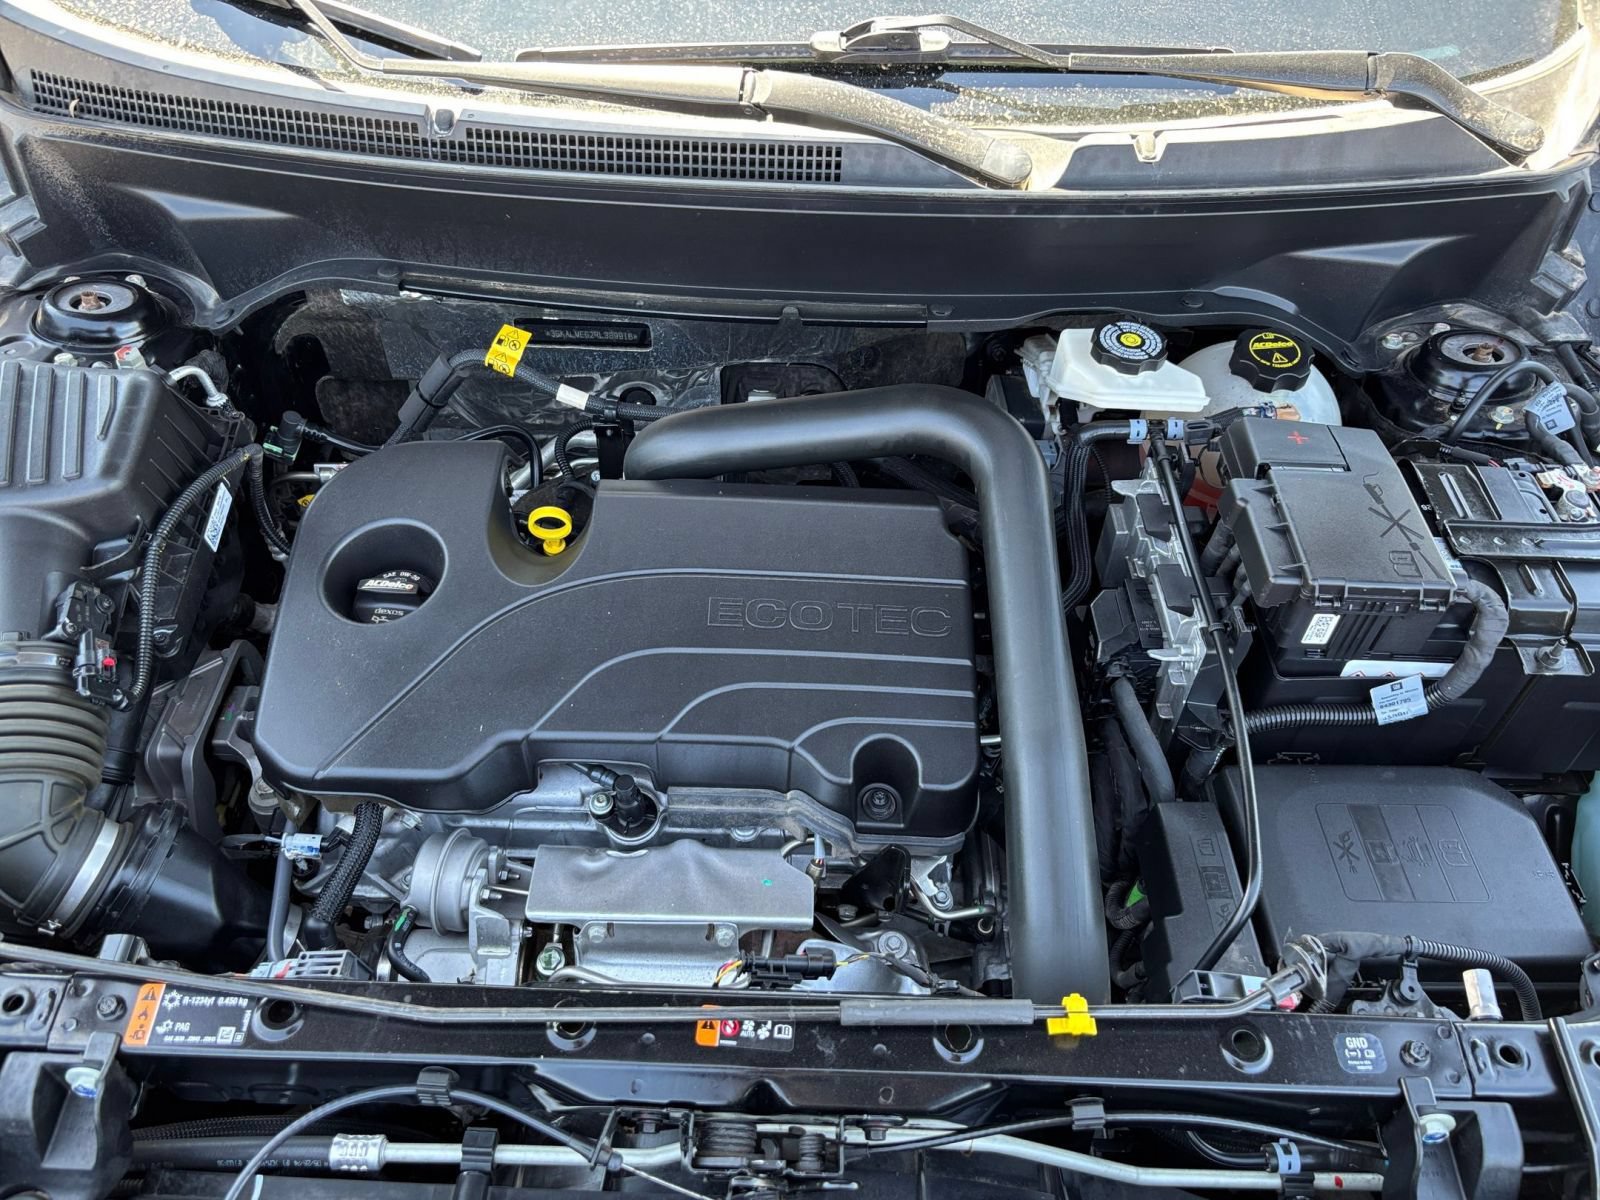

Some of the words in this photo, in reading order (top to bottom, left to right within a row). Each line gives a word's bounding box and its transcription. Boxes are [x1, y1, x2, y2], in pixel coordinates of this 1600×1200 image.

[1252, 341, 1294, 349] ACDelco
[382, 571, 397, 579] SAE
[364, 579, 414, 590] ACDelco
[374, 607, 405, 616] dexos
[707, 596, 952, 638] ECOTEC
[182, 996, 214, 1008] R-1234yf
[238, 997, 249, 1008] kg
[174, 1022, 191, 1031] PAG
[1345, 1037, 1368, 1049] GND
